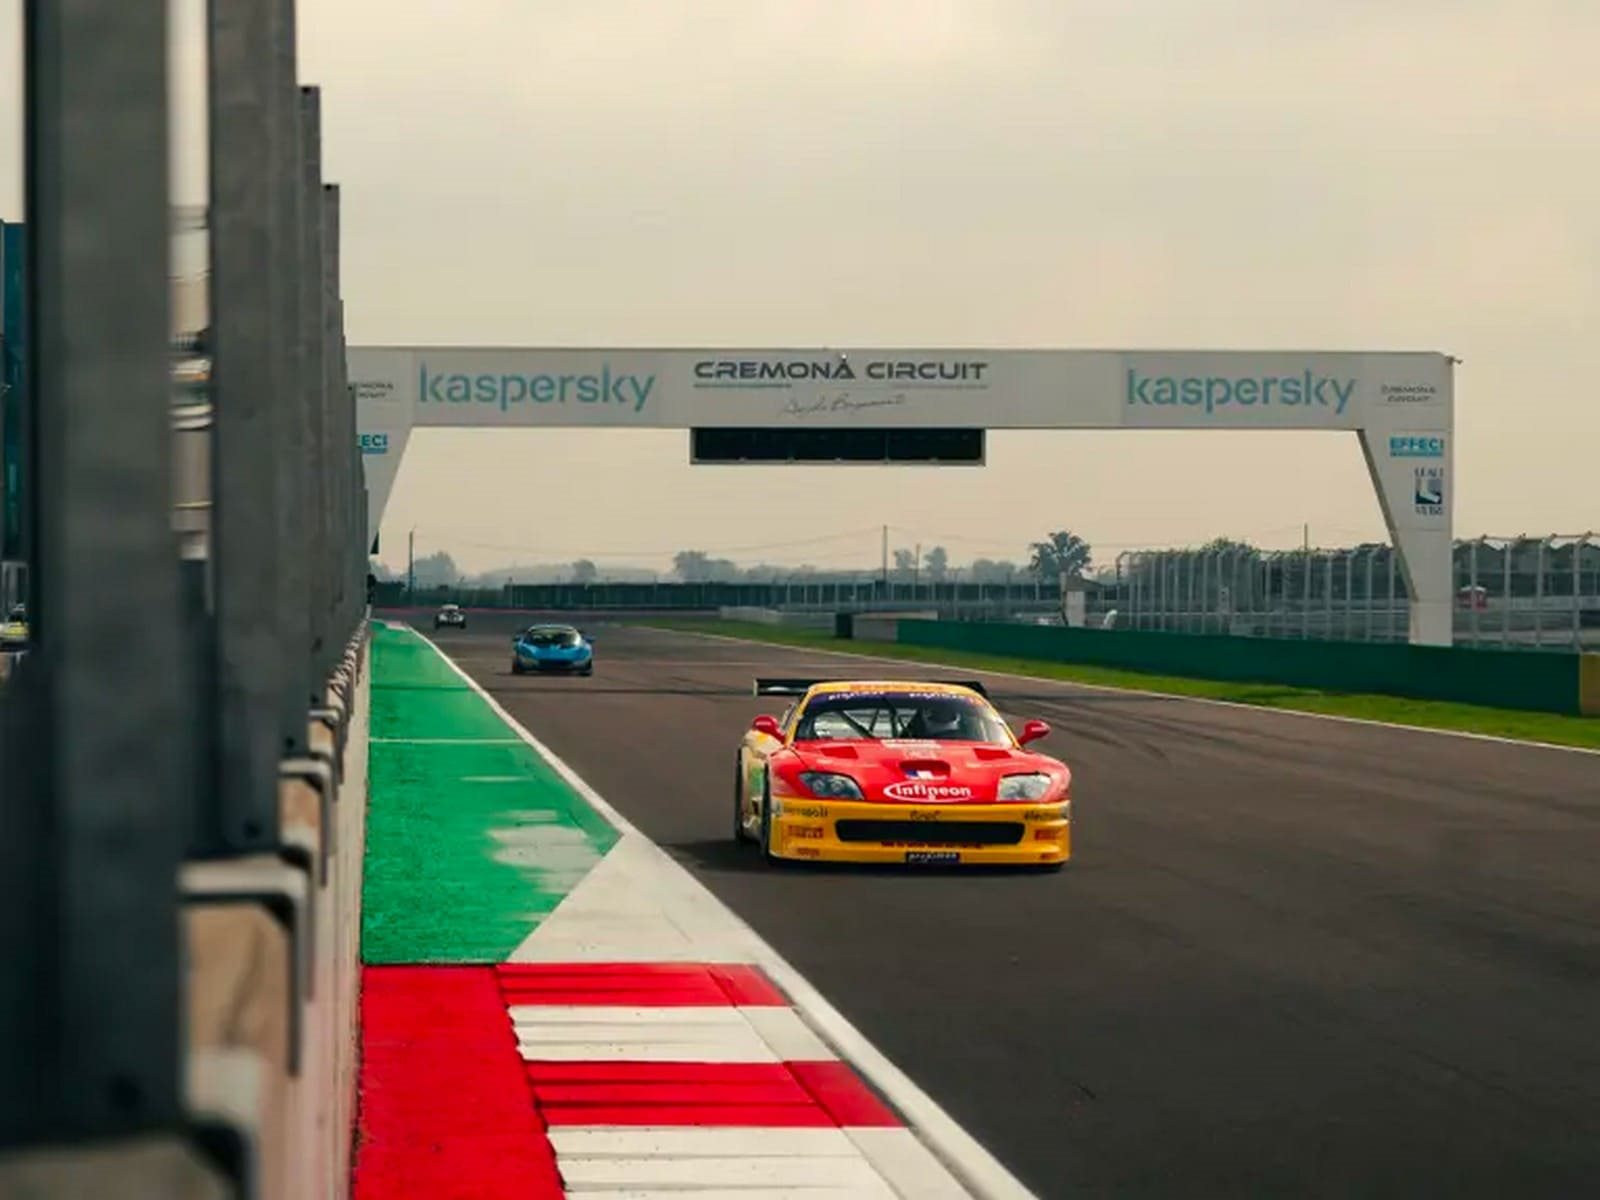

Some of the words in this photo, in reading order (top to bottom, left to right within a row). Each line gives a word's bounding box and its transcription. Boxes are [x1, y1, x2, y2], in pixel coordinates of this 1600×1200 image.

[419, 363, 656, 412] kaspersky
[694, 358, 855, 380] CREMONA
[865, 361, 989, 381] CIRCUIT
[1126, 368, 1356, 414] kaspersky
